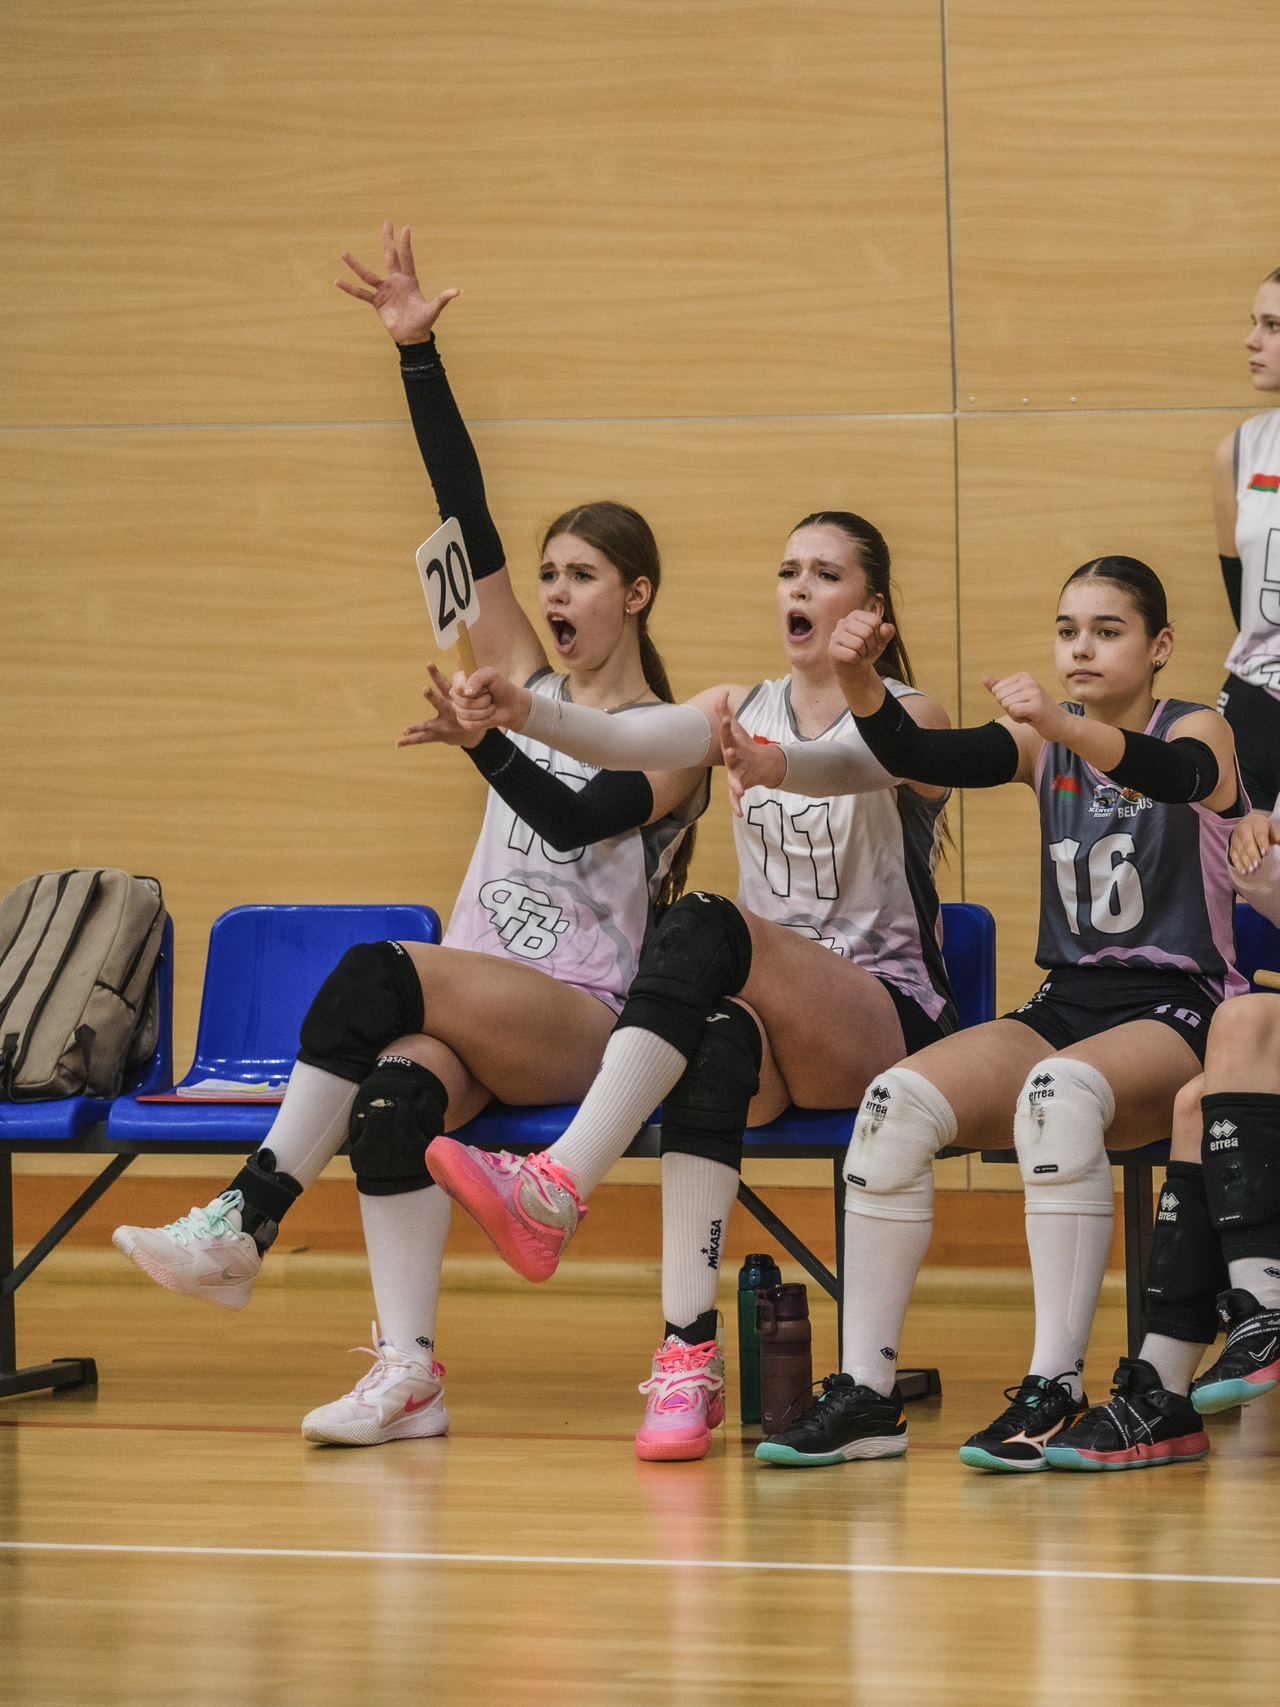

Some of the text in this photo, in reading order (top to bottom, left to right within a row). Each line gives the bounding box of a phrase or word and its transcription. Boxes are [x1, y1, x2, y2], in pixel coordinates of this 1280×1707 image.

[426, 541, 471, 632] 20
[1117, 797, 1153, 818] BELUS
[748, 799, 839, 900] 11
[1049, 832, 1145, 936] 16
[384, 1055, 412, 1067] asics
[708, 1219, 722, 1270] MIKASA
